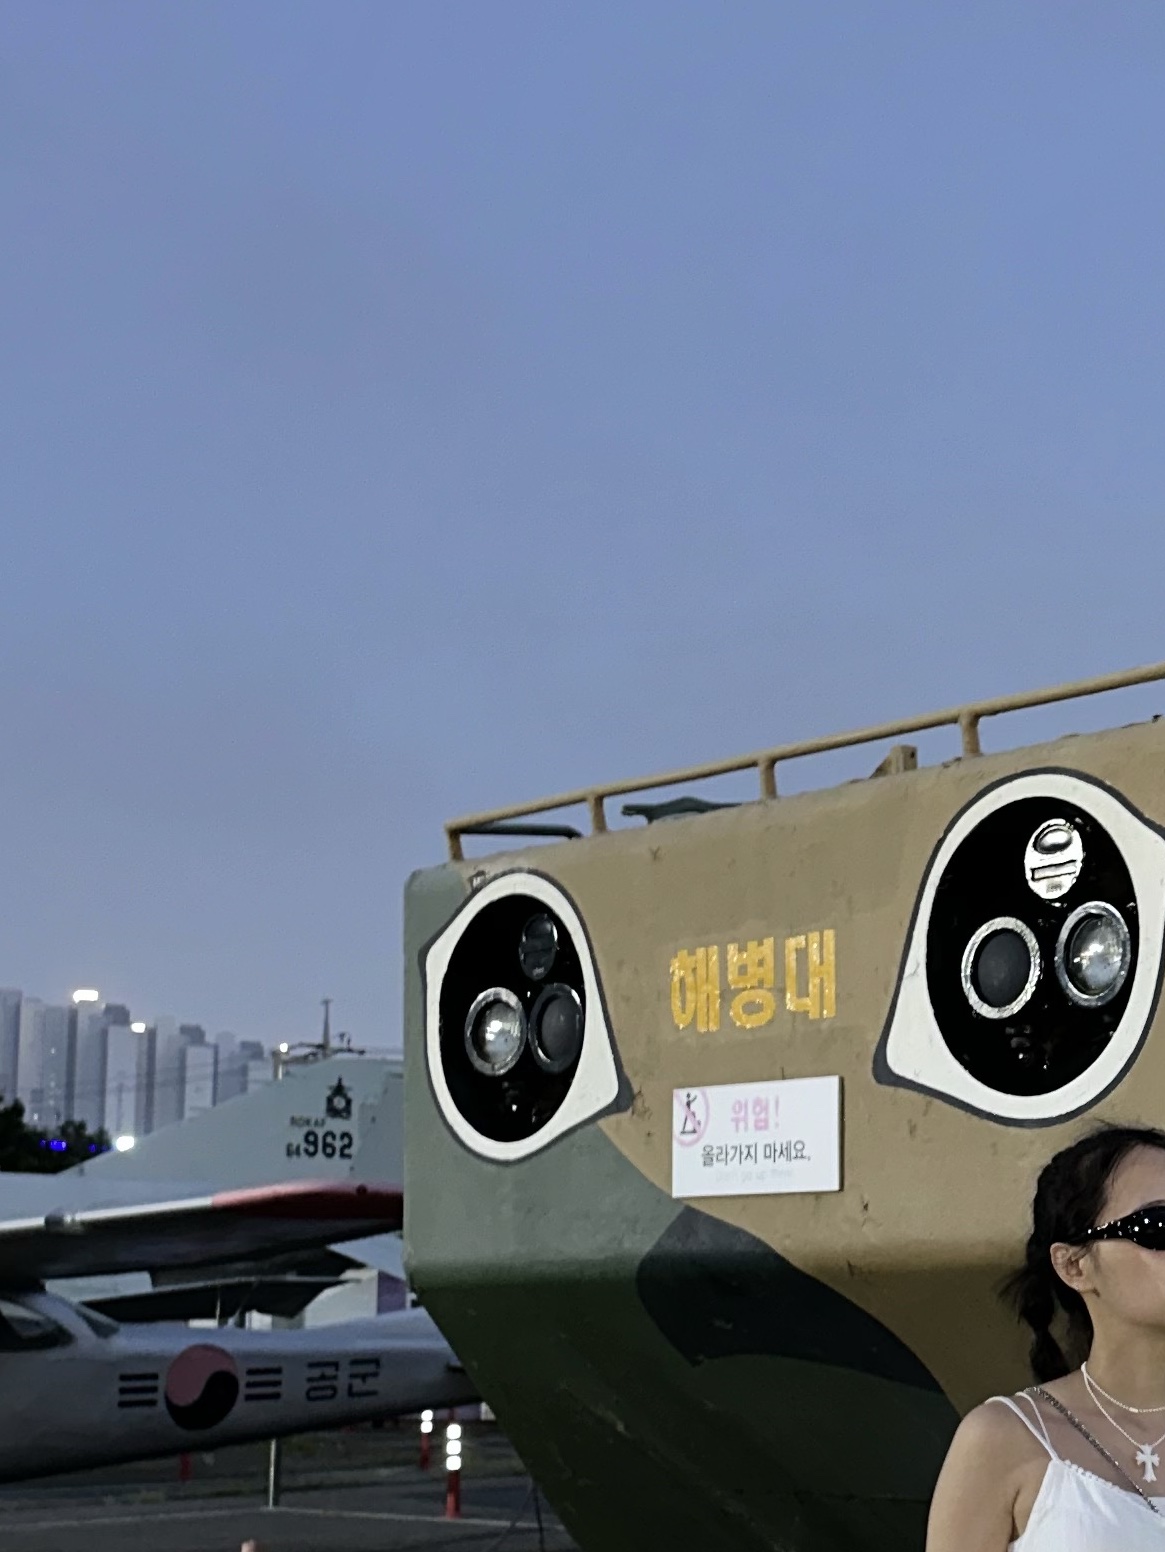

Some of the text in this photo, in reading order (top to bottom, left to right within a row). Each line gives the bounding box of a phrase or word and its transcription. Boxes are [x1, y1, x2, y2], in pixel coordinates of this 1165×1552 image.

[669, 929, 836, 1033] 해병대
[731, 1095, 780, 1133] 위험!
[701, 1139, 812, 1167] 올라가지 마세요.
[305, 1358, 381, 1402] 공군
